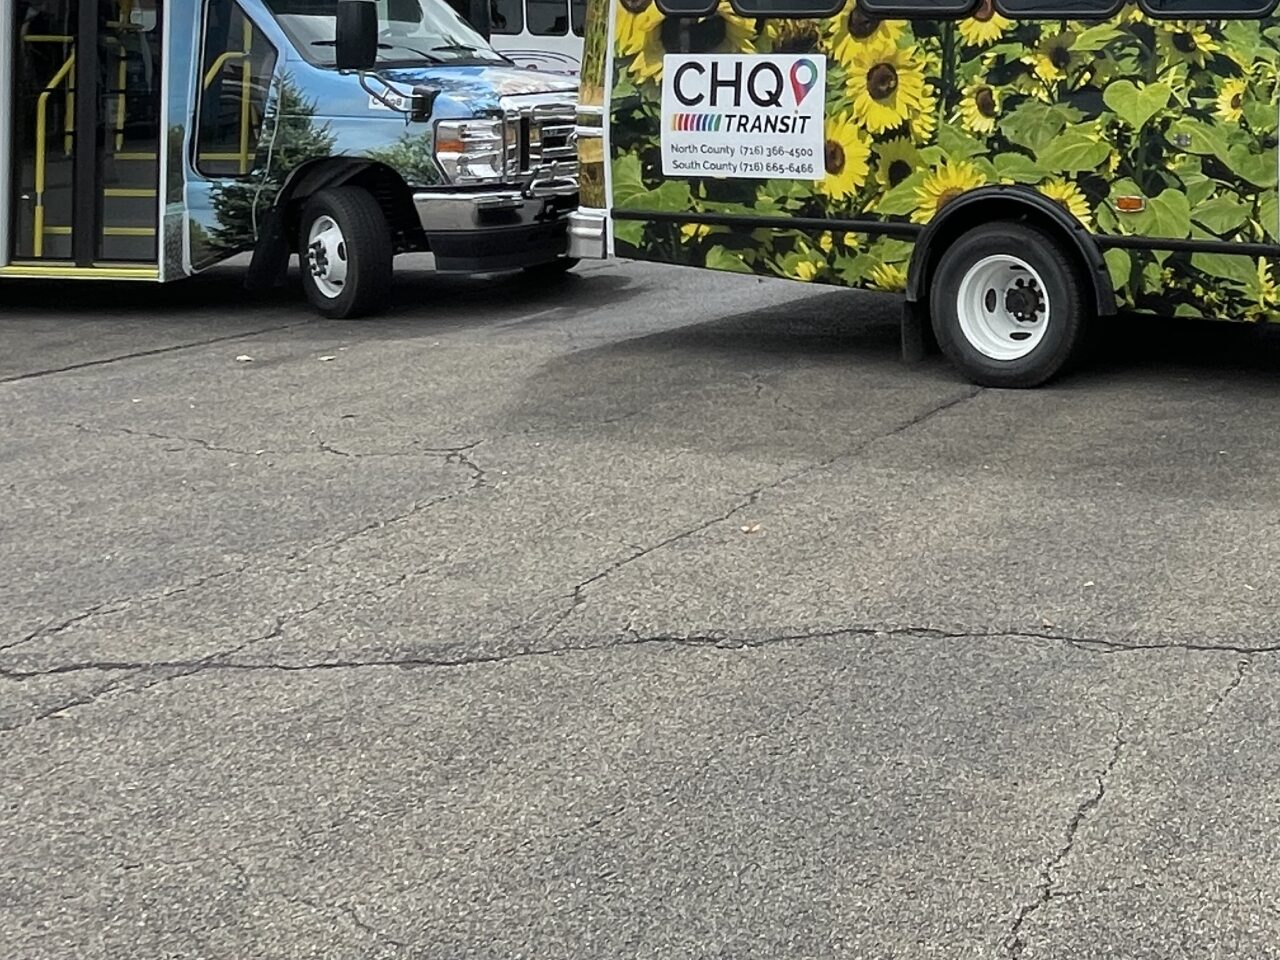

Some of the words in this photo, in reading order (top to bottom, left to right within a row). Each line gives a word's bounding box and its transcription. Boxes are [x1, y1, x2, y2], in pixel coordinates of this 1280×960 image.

[673, 61, 784, 108] CHQ
[671, 144, 698, 155] North
[700, 144, 735, 157] County
[740, 145, 764, 157] (716)
[766, 147, 813, 158] 366-4500
[672, 160, 700, 171] South
[702, 161, 737, 174] County
[739, 162, 764, 174] (716)
[766, 163, 814, 174] 665-6466
